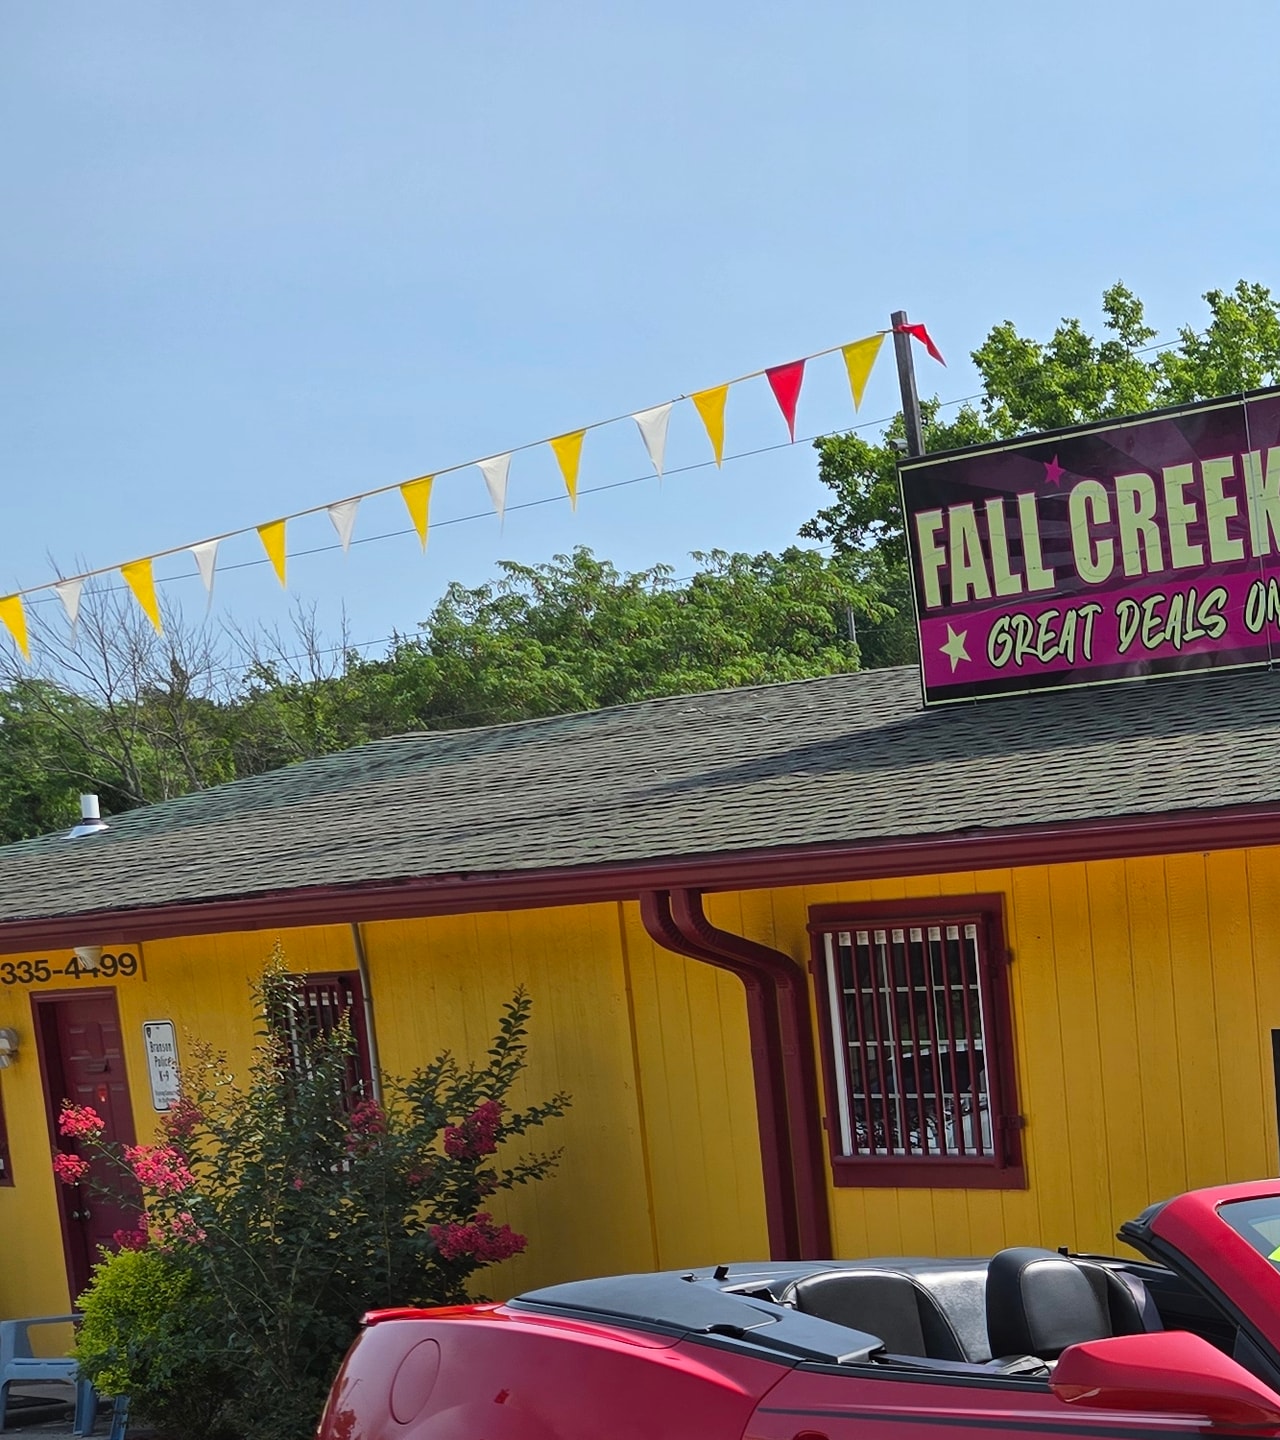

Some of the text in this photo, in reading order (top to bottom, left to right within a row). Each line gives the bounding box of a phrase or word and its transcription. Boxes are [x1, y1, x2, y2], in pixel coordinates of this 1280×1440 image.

[913, 490, 1056, 609] FALL
[985, 600, 1102, 671] GREAT
[1115, 585, 1228, 654] DEALS
[149, 1041, 173, 1053] Branson
